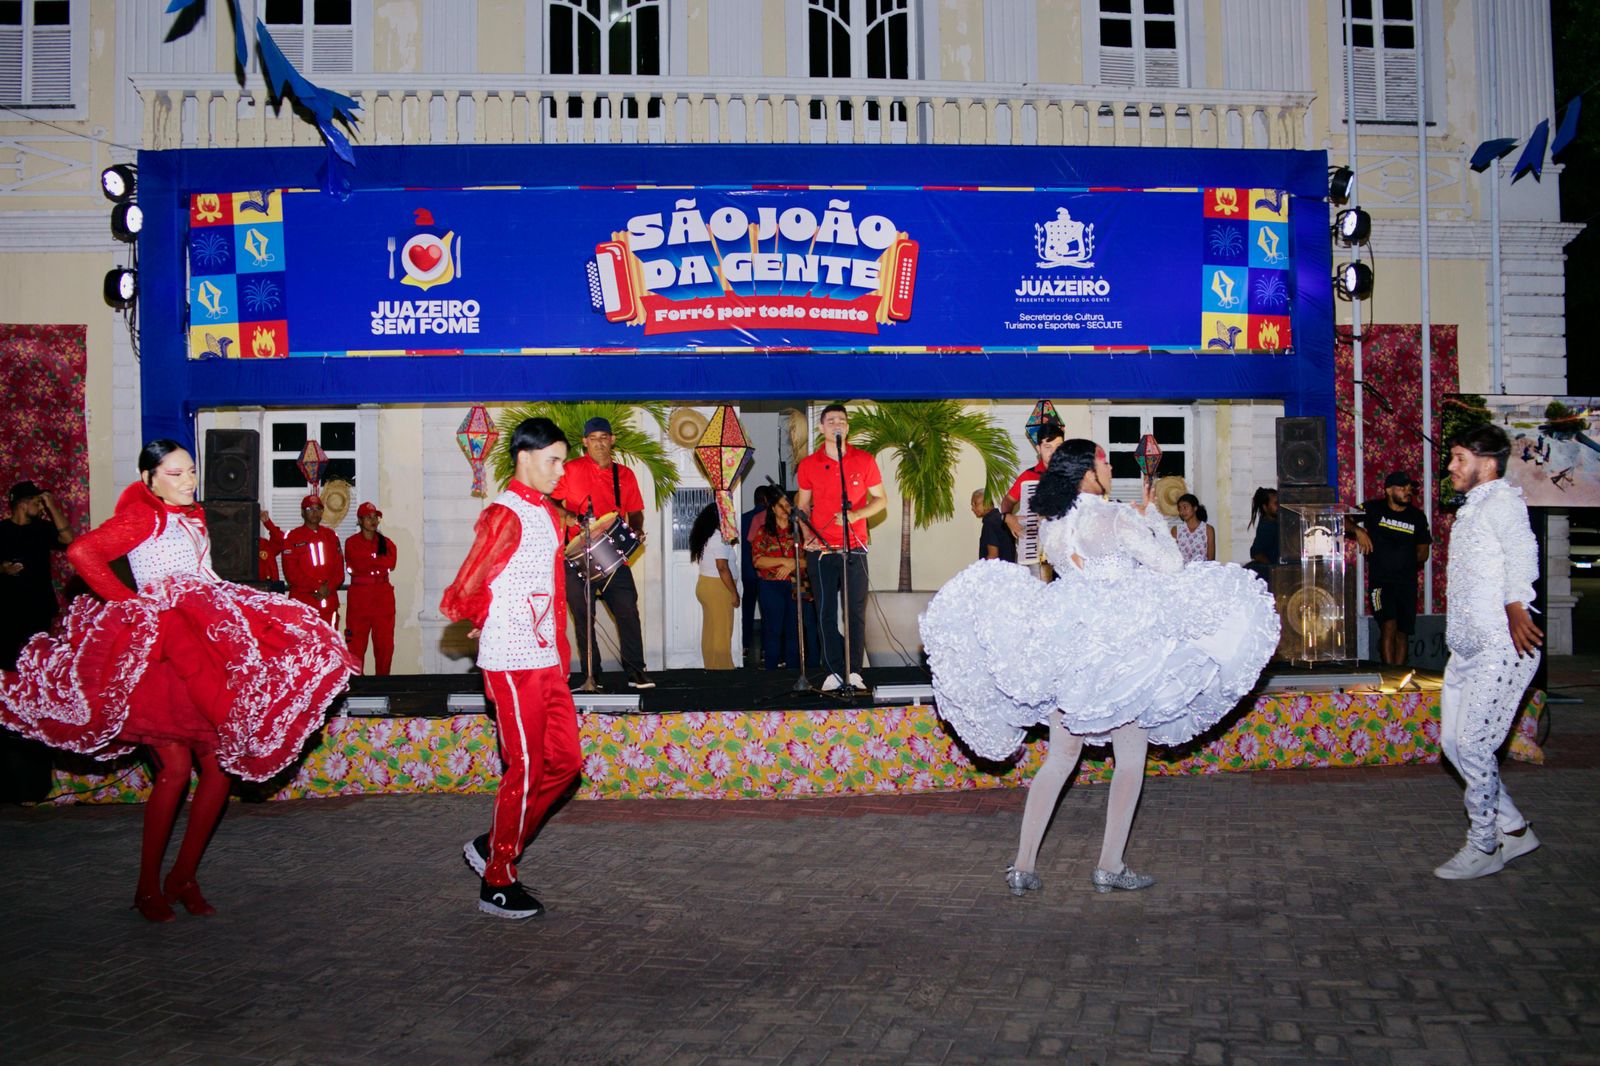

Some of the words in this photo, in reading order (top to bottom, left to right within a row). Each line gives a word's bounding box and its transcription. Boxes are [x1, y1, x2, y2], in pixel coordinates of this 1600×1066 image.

[627, 198, 748, 251] SÃO
[757, 198, 897, 250] JOÃO
[643, 255, 713, 290] DA
[721, 253, 883, 290] GENTE
[1015, 280, 1111, 296] JUAZEIRO
[371, 300, 480, 318] JUAZEIRO
[655, 304, 715, 322] Forró
[718, 305, 756, 321] por
[759, 304, 806, 319] todo
[808, 305, 869, 322] canto
[1019, 313, 1061, 321] Secretaria
[1062, 313, 1073, 321] de
[371, 318, 416, 335] SEM
[419, 317, 480, 334] FOME
[1004, 321, 1036, 330] Turismo
[1044, 321, 1081, 331] Esportes
[1086, 321, 1123, 330] SECULTE
